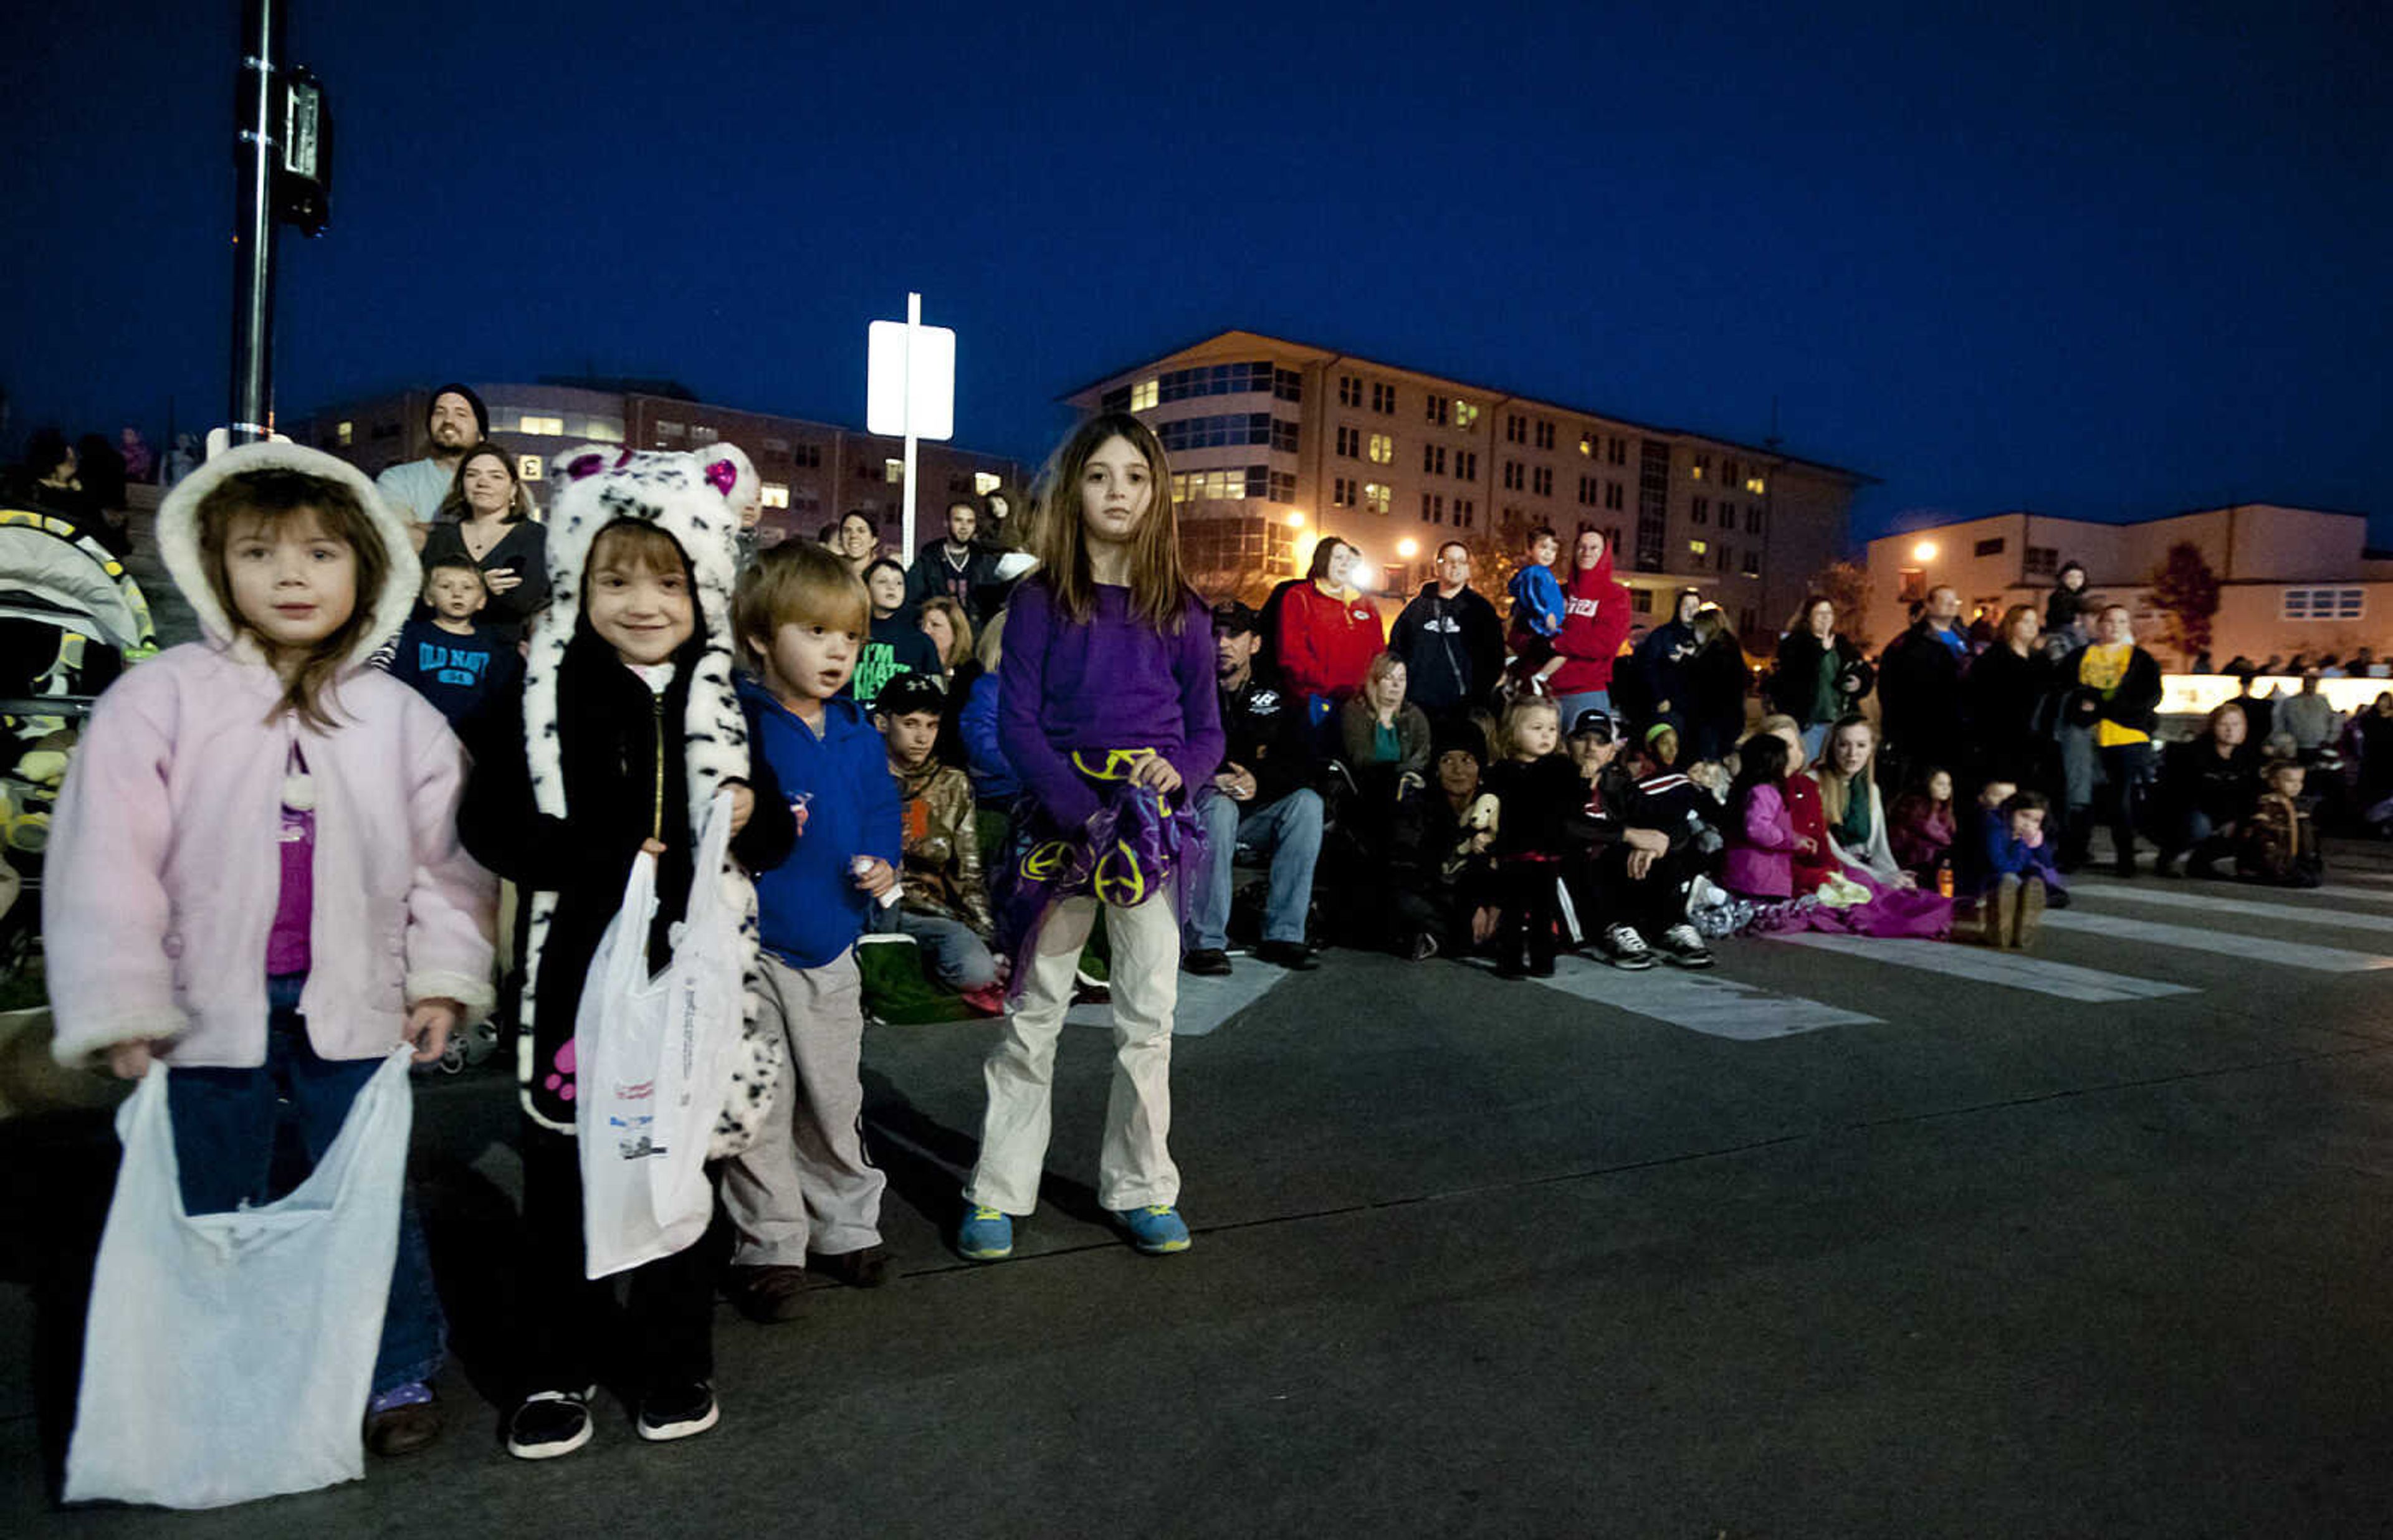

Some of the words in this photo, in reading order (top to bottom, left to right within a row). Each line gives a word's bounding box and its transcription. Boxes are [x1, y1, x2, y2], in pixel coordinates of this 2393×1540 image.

[419, 642, 448, 671] OLD
[449, 649, 489, 678] NAVY
[863, 642, 894, 662] I'M
